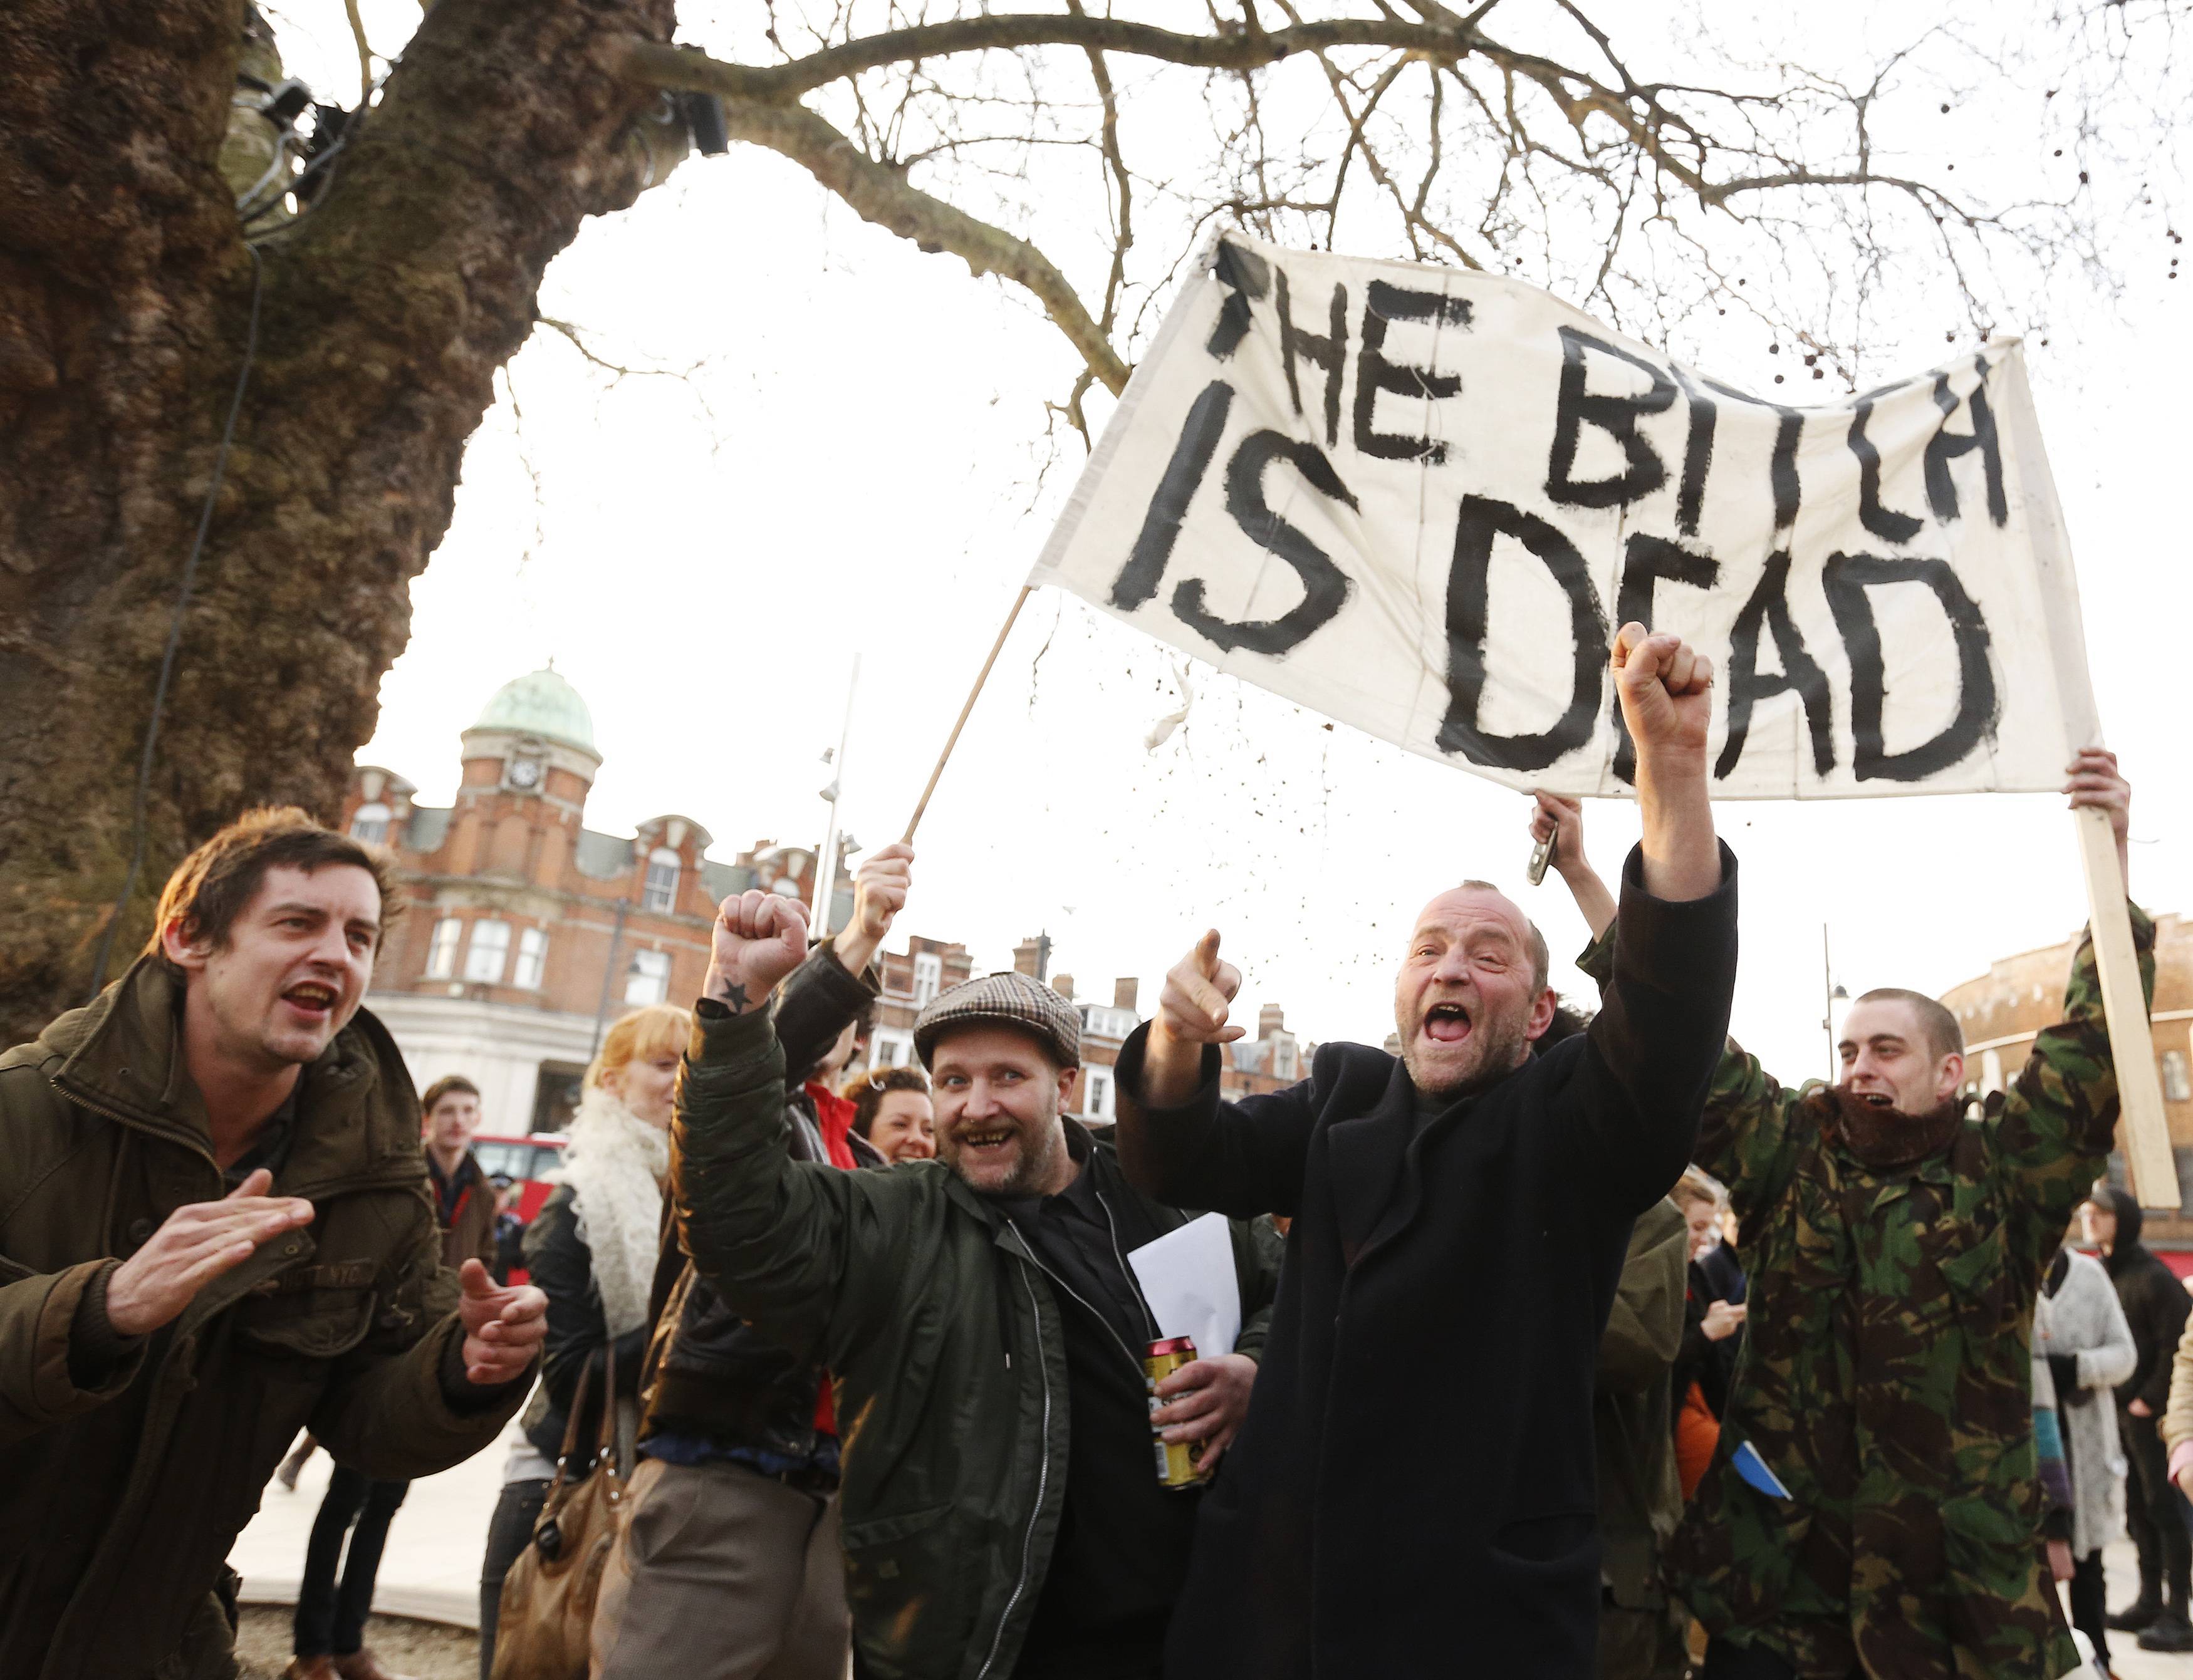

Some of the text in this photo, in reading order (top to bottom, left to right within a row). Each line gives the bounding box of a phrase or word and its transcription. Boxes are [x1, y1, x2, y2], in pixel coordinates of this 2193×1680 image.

[1105, 379, 1362, 655] IS
[1207, 239, 2009, 546] THE BITCH
